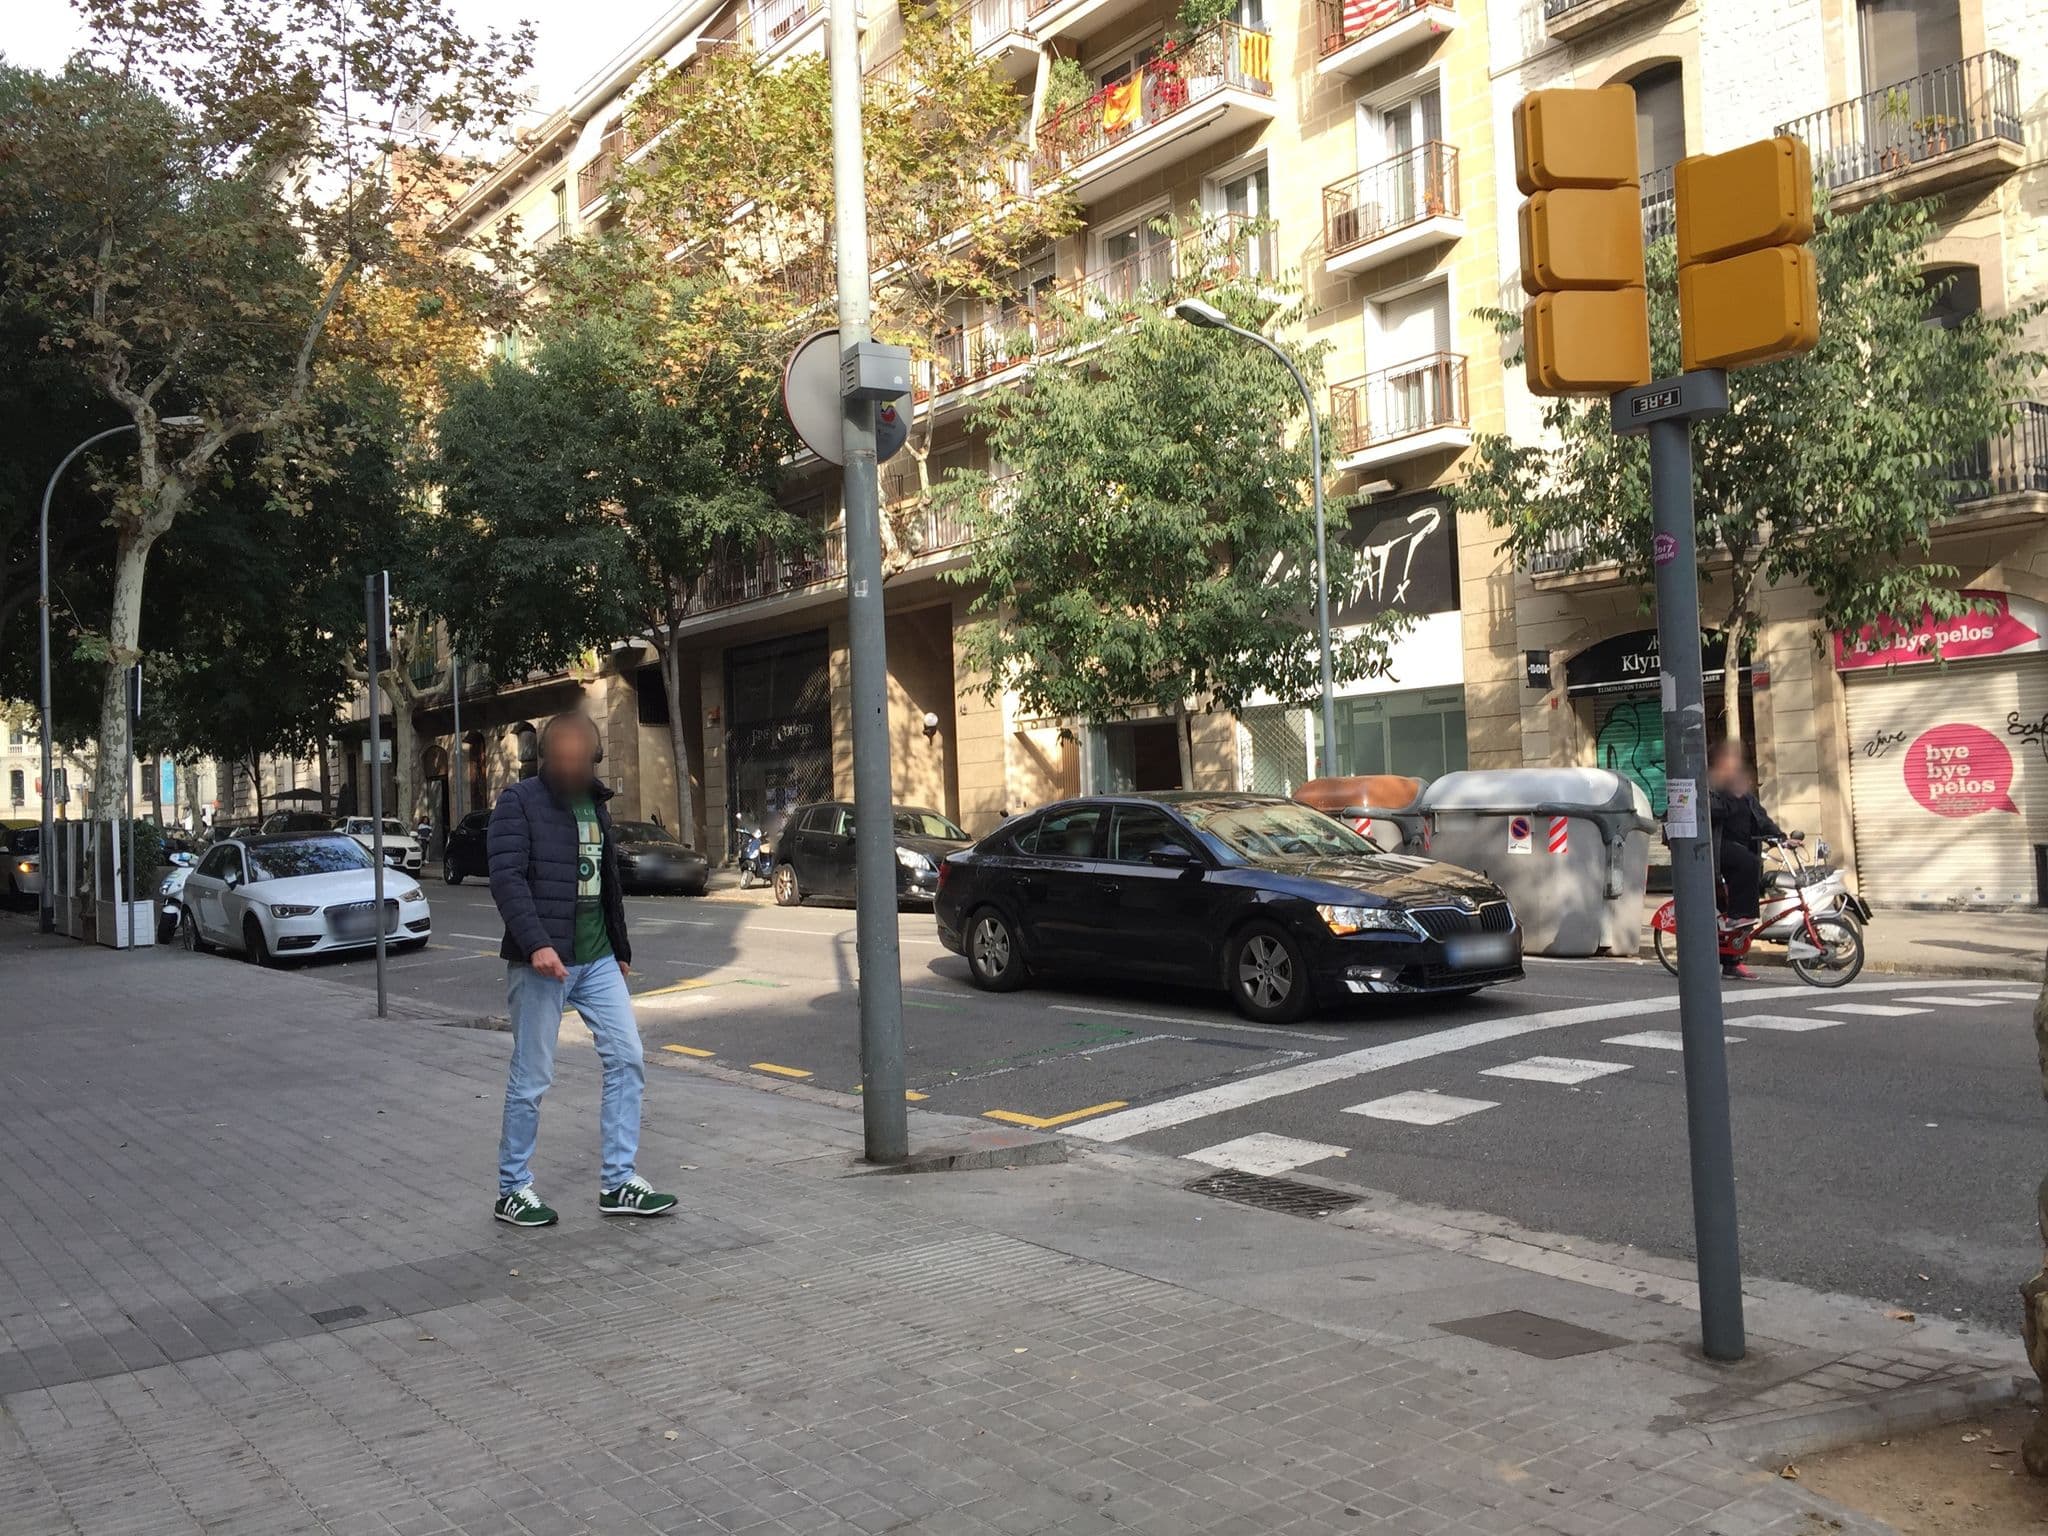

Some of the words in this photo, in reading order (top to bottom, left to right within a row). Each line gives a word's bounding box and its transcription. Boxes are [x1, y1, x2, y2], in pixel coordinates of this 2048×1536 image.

[1894, 632, 1931, 653] bye
[1935, 625, 1994, 649] pelos
[1621, 653, 1661, 674] Klyn
[1925, 744, 1970, 763] bye
[1926, 762, 1972, 782] bye
[1929, 778, 1996, 801] pelos
